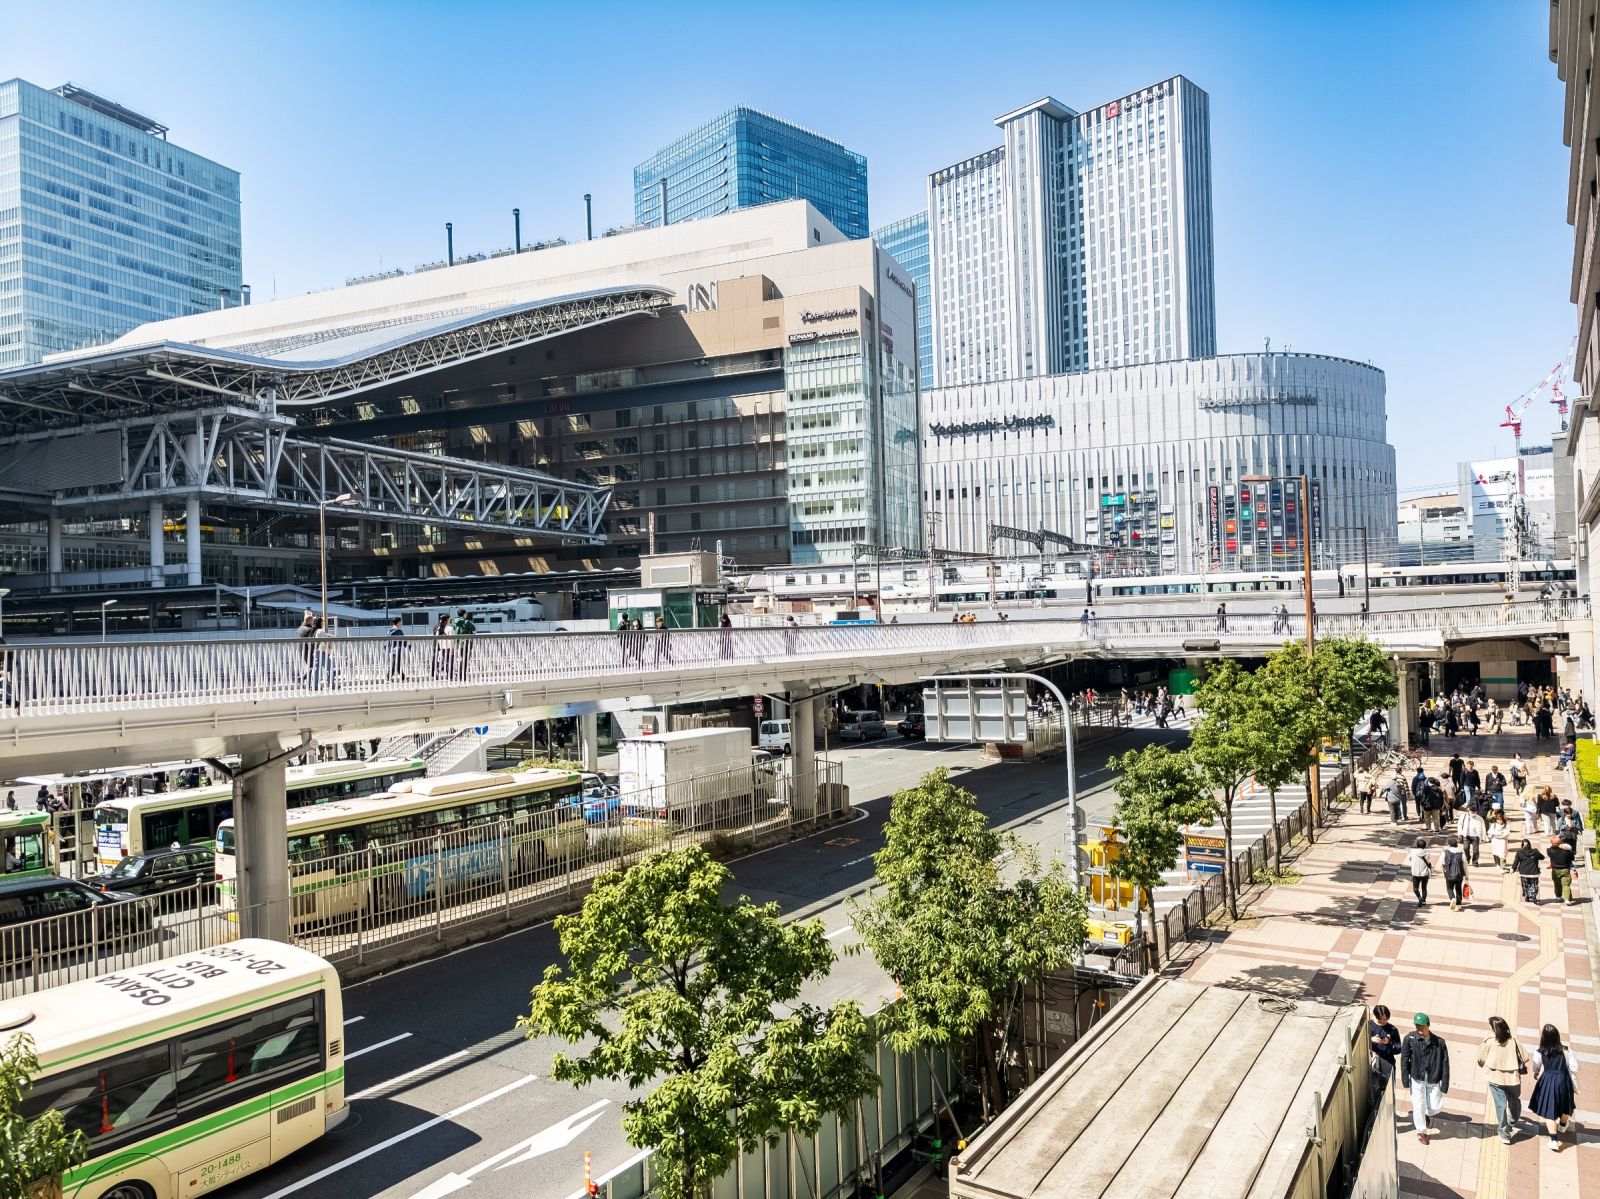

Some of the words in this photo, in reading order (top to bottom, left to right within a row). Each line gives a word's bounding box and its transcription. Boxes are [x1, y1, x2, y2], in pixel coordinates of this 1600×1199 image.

[817, 329, 840, 338] SPORTS
[841, 328, 856, 336] CLUB
[139, 969, 195, 989] CITY
[176, 960, 228, 979] BUS
[95, 974, 172, 1006] OSAKA
[200, 1153, 241, 1177] 20-1488
